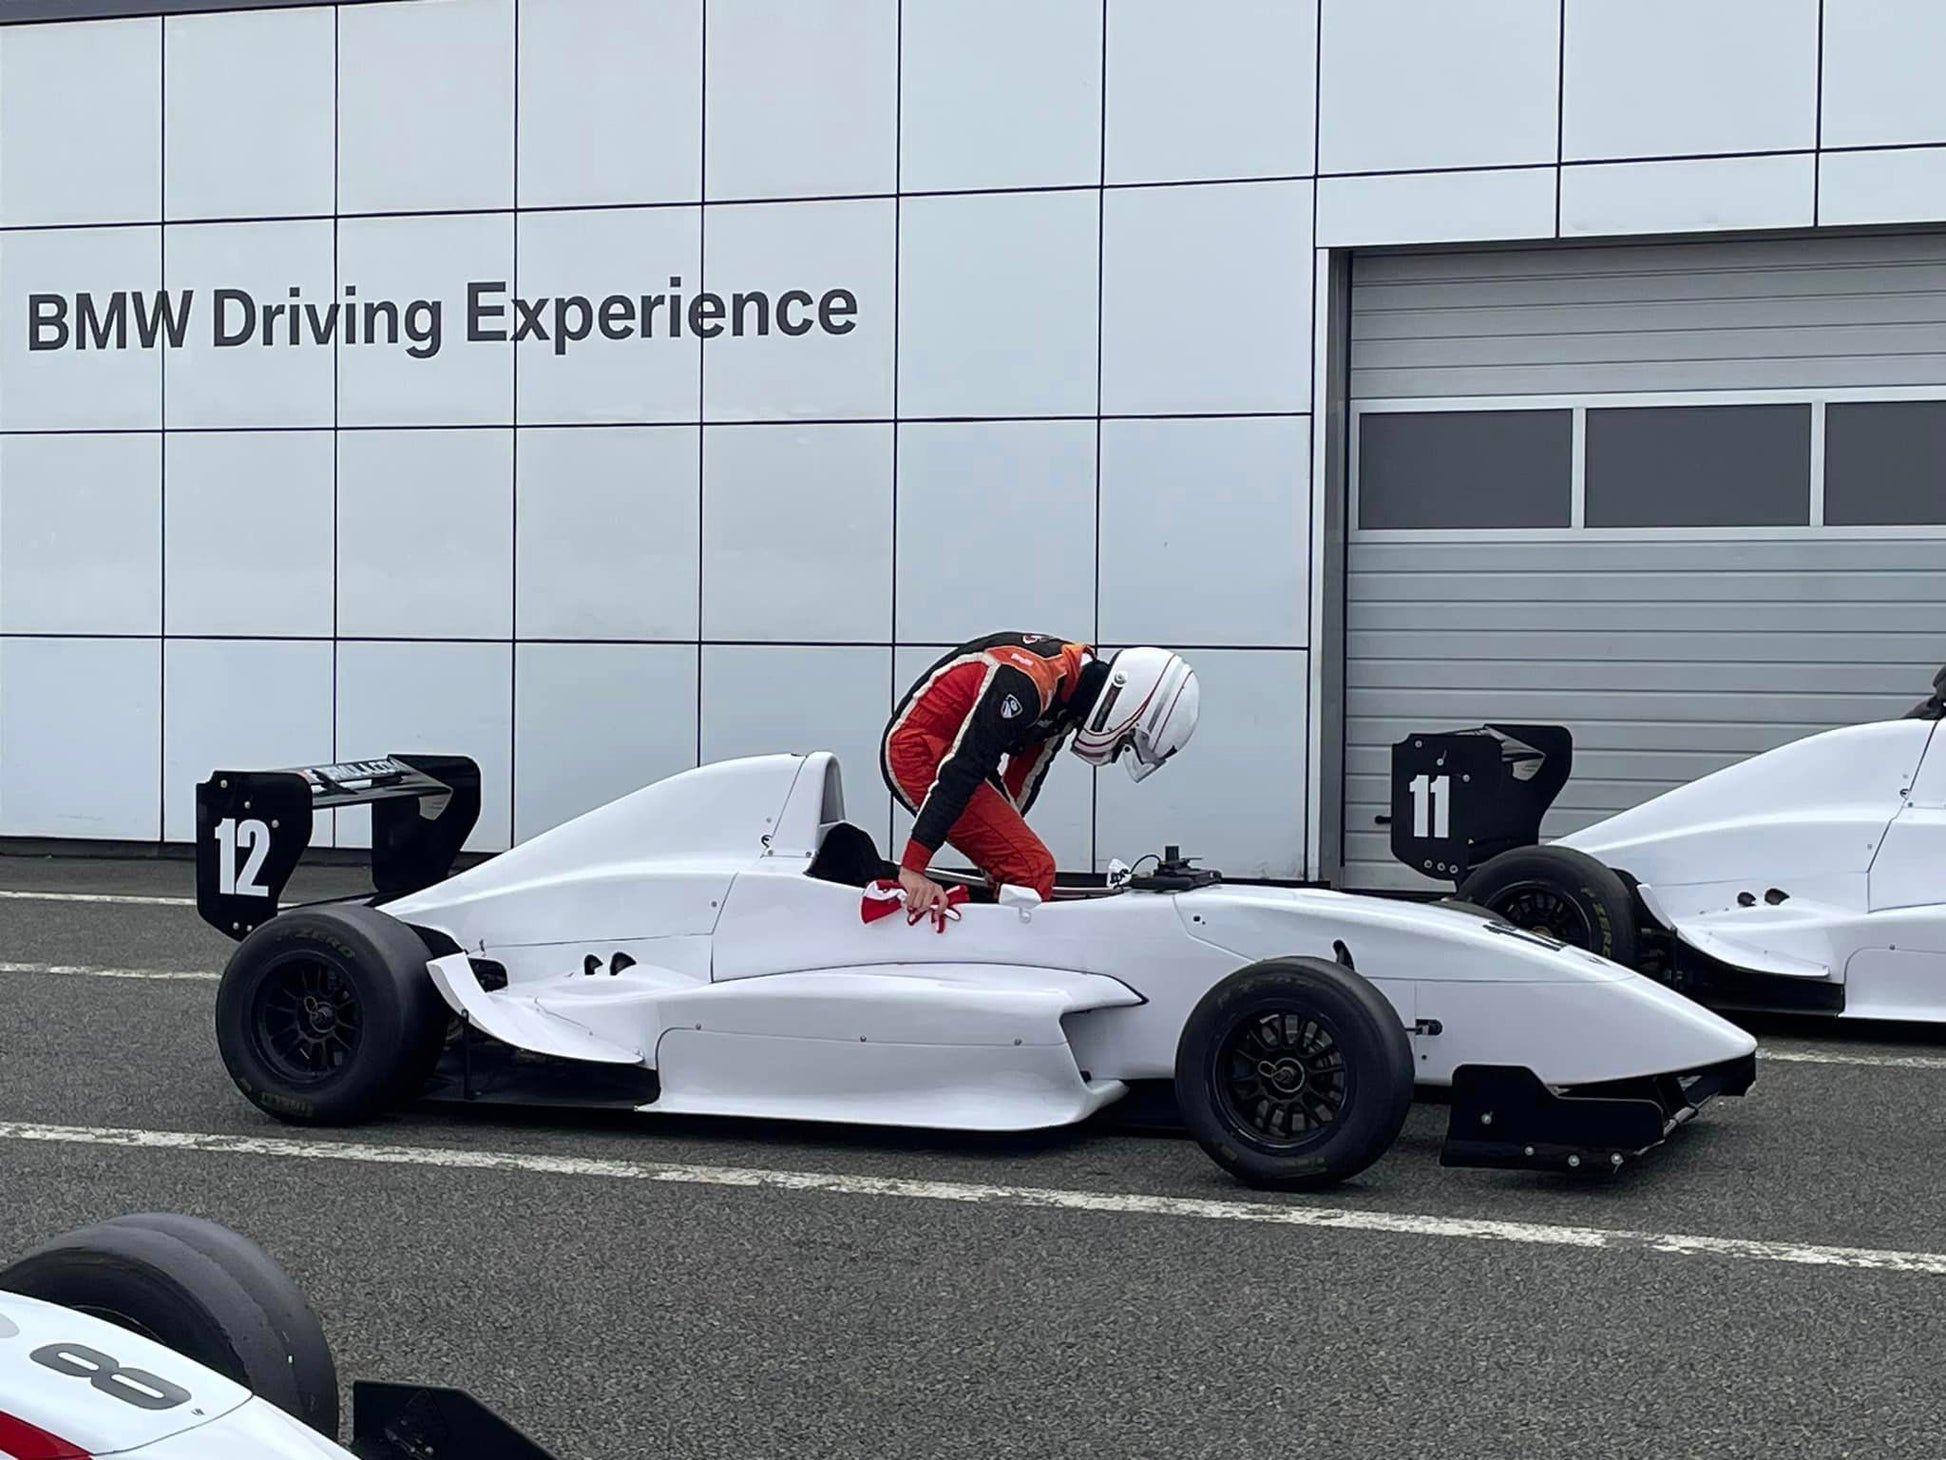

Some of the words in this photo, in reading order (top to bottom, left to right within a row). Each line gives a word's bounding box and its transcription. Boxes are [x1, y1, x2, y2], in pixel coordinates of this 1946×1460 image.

[28, 289, 194, 351] BMW
[213, 285, 442, 359] Driving
[466, 276, 858, 355] Experience
[1409, 774, 1450, 839] 11
[214, 817, 271, 897] 12
[29, 1342, 192, 1411] 8
